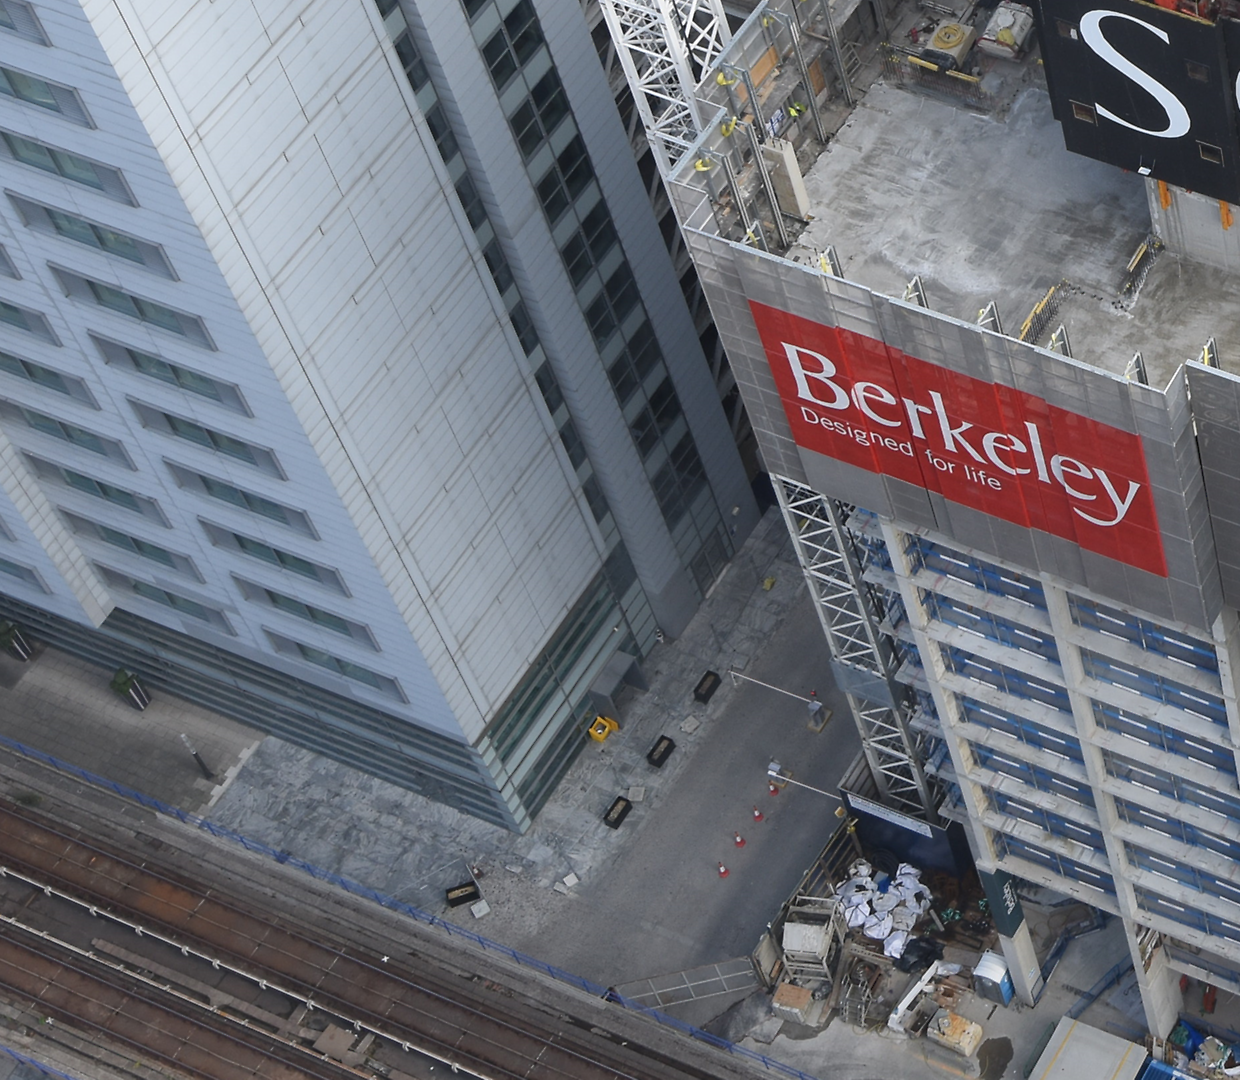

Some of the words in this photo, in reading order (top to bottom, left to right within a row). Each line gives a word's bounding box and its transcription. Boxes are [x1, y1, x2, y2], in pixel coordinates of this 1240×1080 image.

[781, 341, 1140, 527] Berkeley
[801, 406, 914, 458] Designed
[925, 450, 955, 474] for
[965, 465, 1002, 491] life
